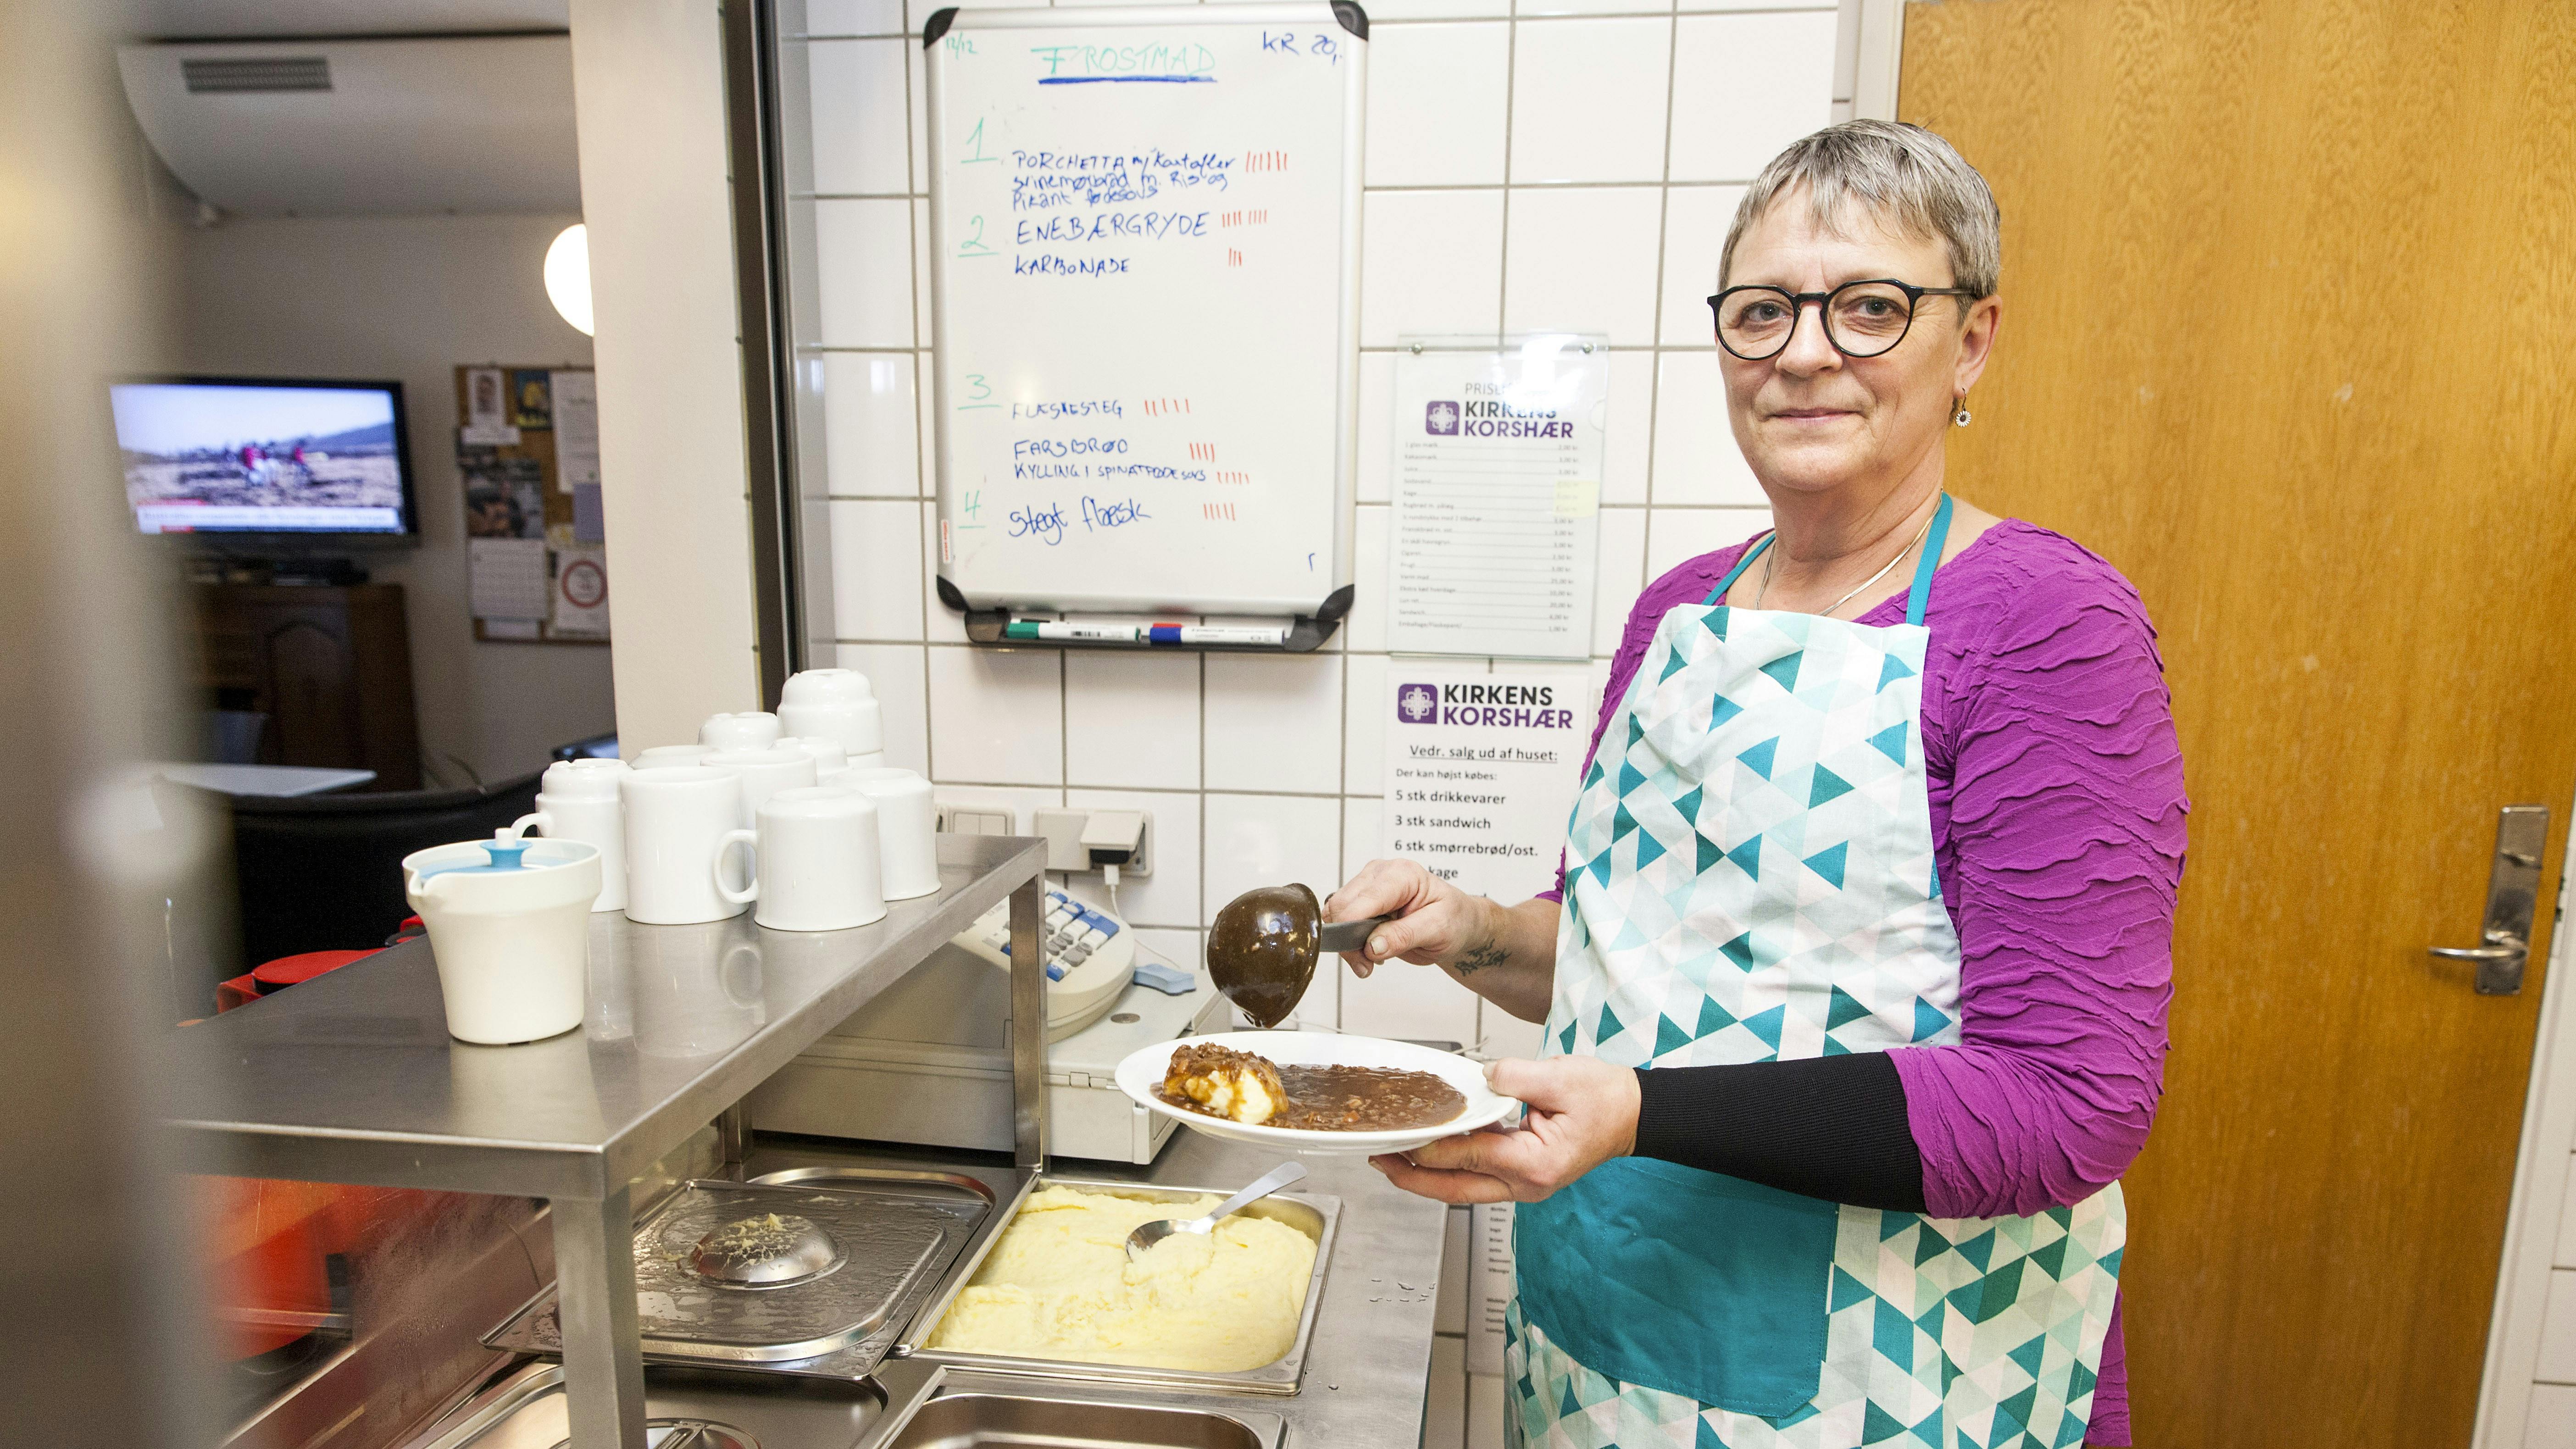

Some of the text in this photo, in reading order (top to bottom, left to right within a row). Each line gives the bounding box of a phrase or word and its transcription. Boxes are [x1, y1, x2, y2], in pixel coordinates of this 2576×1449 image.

[1263, 31, 1299, 56] KR
[1031, 41, 1215, 76] FROSTMAD
[966, 117, 983, 159] 1
[1012, 150, 1125, 170] PORCHETTA
[961, 215, 989, 249] 2
[1017, 212, 1210, 244] ENEBÆRGRYDE
[1015, 255, 1129, 277] KARBONADE
[966, 374, 991, 400] 3
[1465, 421, 1574, 438] KORSHÆR
[1015, 438, 1127, 459] FARSBRØD
[1015, 462, 1079, 479] KYLLING
[965, 489, 981, 520] 4
[1444, 684, 1553, 706] KIRKENS
[1444, 706, 1573, 729] KORSHÆR
[1410, 745, 1558, 761] Vedr. salg ud af huset:
[1397, 769, 1497, 781] Der kan højst købes:
[1396, 790, 1506, 804] 5 stk drikkevarer
[1395, 816, 1491, 829] 3 stk sandwich
[1395, 840, 1538, 856] 6 stk smørrebrød/ost.
